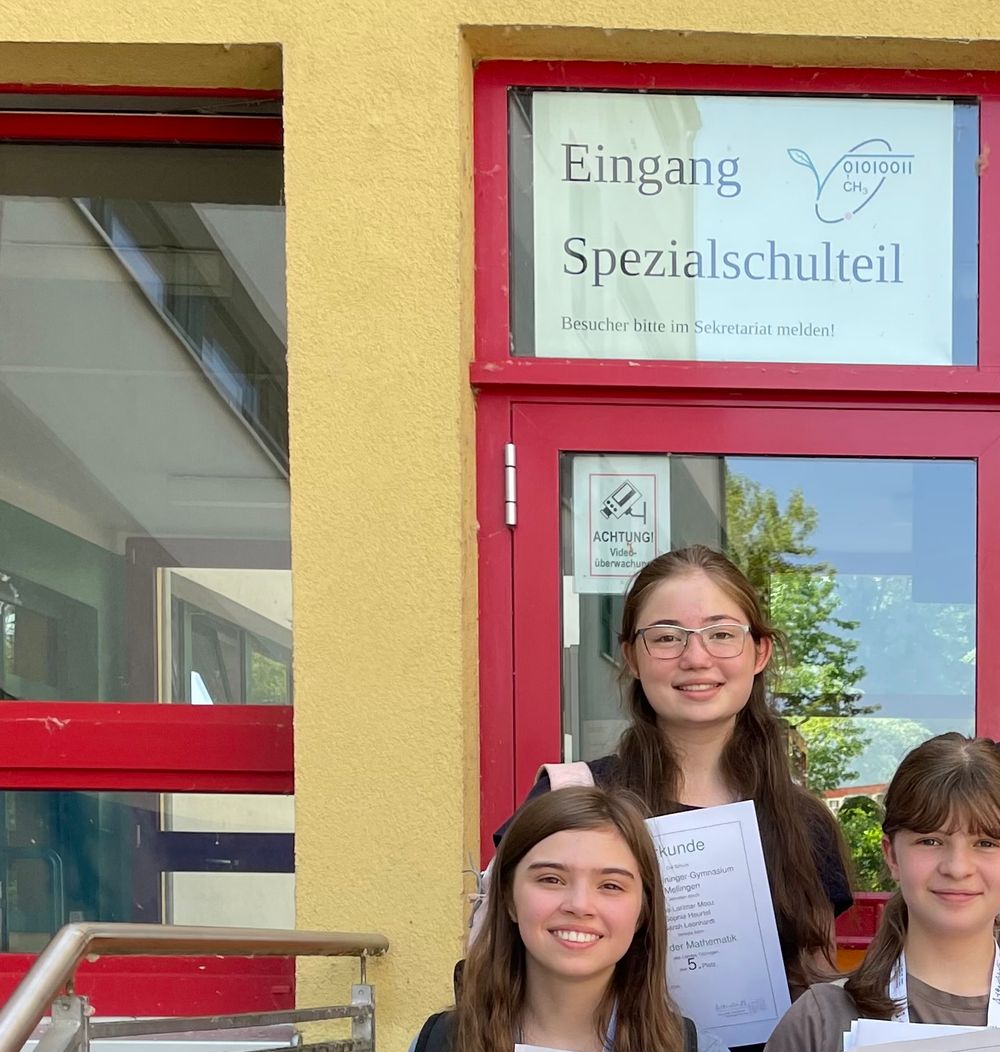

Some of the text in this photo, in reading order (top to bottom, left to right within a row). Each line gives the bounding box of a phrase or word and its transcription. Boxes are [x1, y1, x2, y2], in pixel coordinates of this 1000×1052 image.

[561, 142, 741, 197] Eingang
[843, 160, 912, 176] 01010011
[563, 236, 903, 287] Spezialschulteil
[561, 315, 835, 337] Besucher bitte im Sekretariat melden!
[593, 531, 653, 543] ACHTUNG!
[610, 548, 637, 557] Video-
[595, 559, 648, 568] überwachun
[656, 839, 705, 858] kunde
[669, 934, 737, 952] der Mathematik
